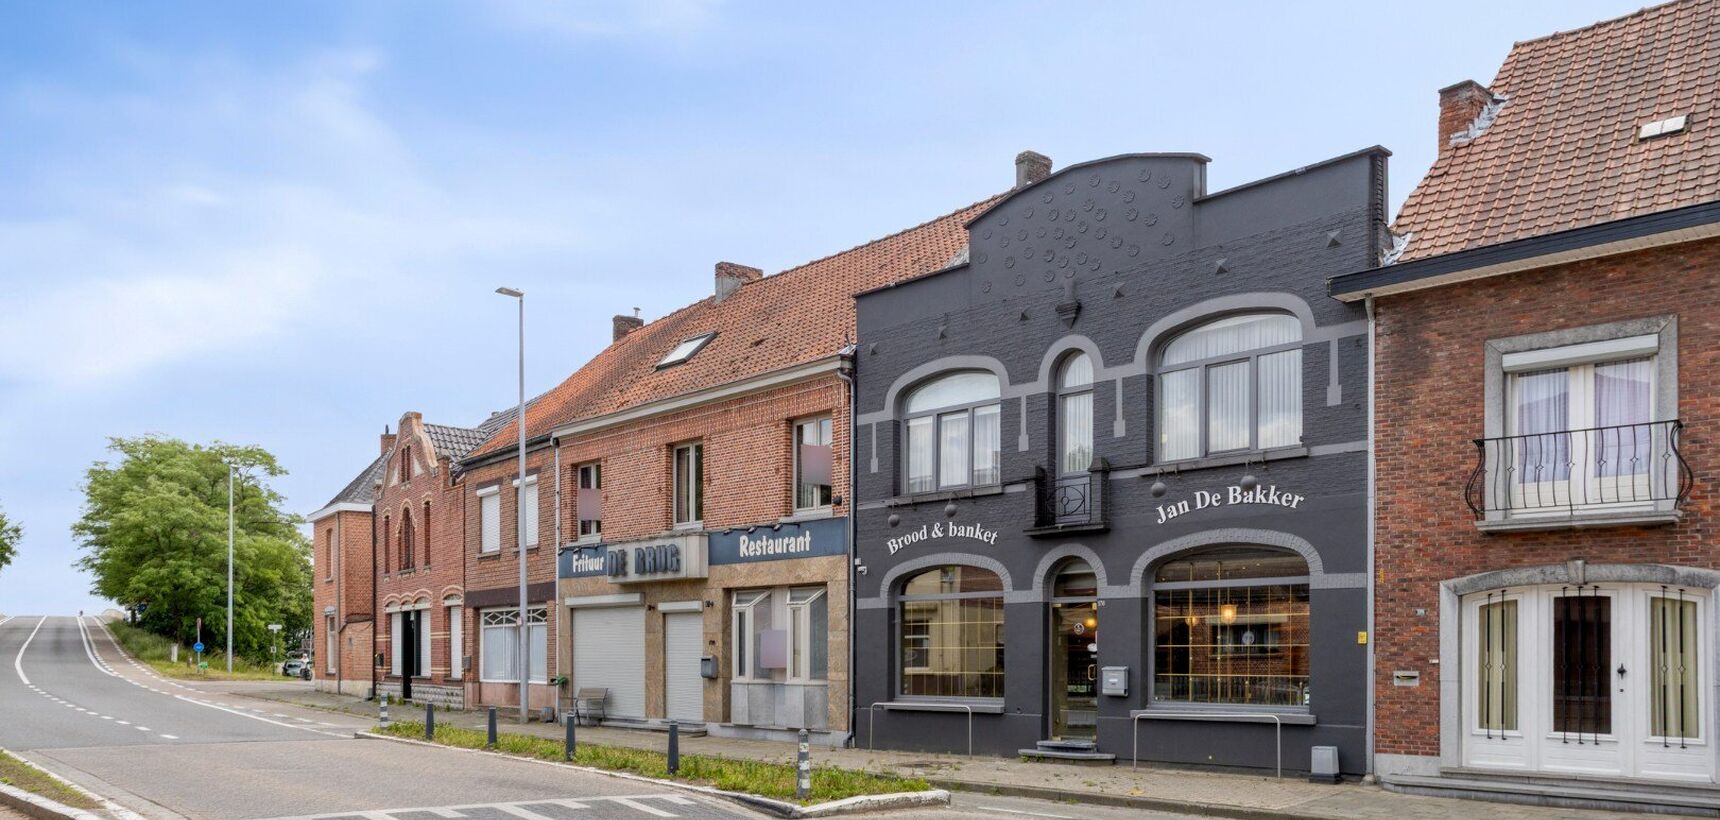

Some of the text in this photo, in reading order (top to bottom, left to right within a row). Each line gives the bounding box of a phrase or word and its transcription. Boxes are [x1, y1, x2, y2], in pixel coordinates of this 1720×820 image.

[1156, 484, 1305, 524] Jan De Bakker
[739, 530, 811, 557] Restaurant
[886, 521, 998, 556] Brood & banket
[572, 553, 605, 573] Frituur
[608, 544, 680, 577] DE BRUG
